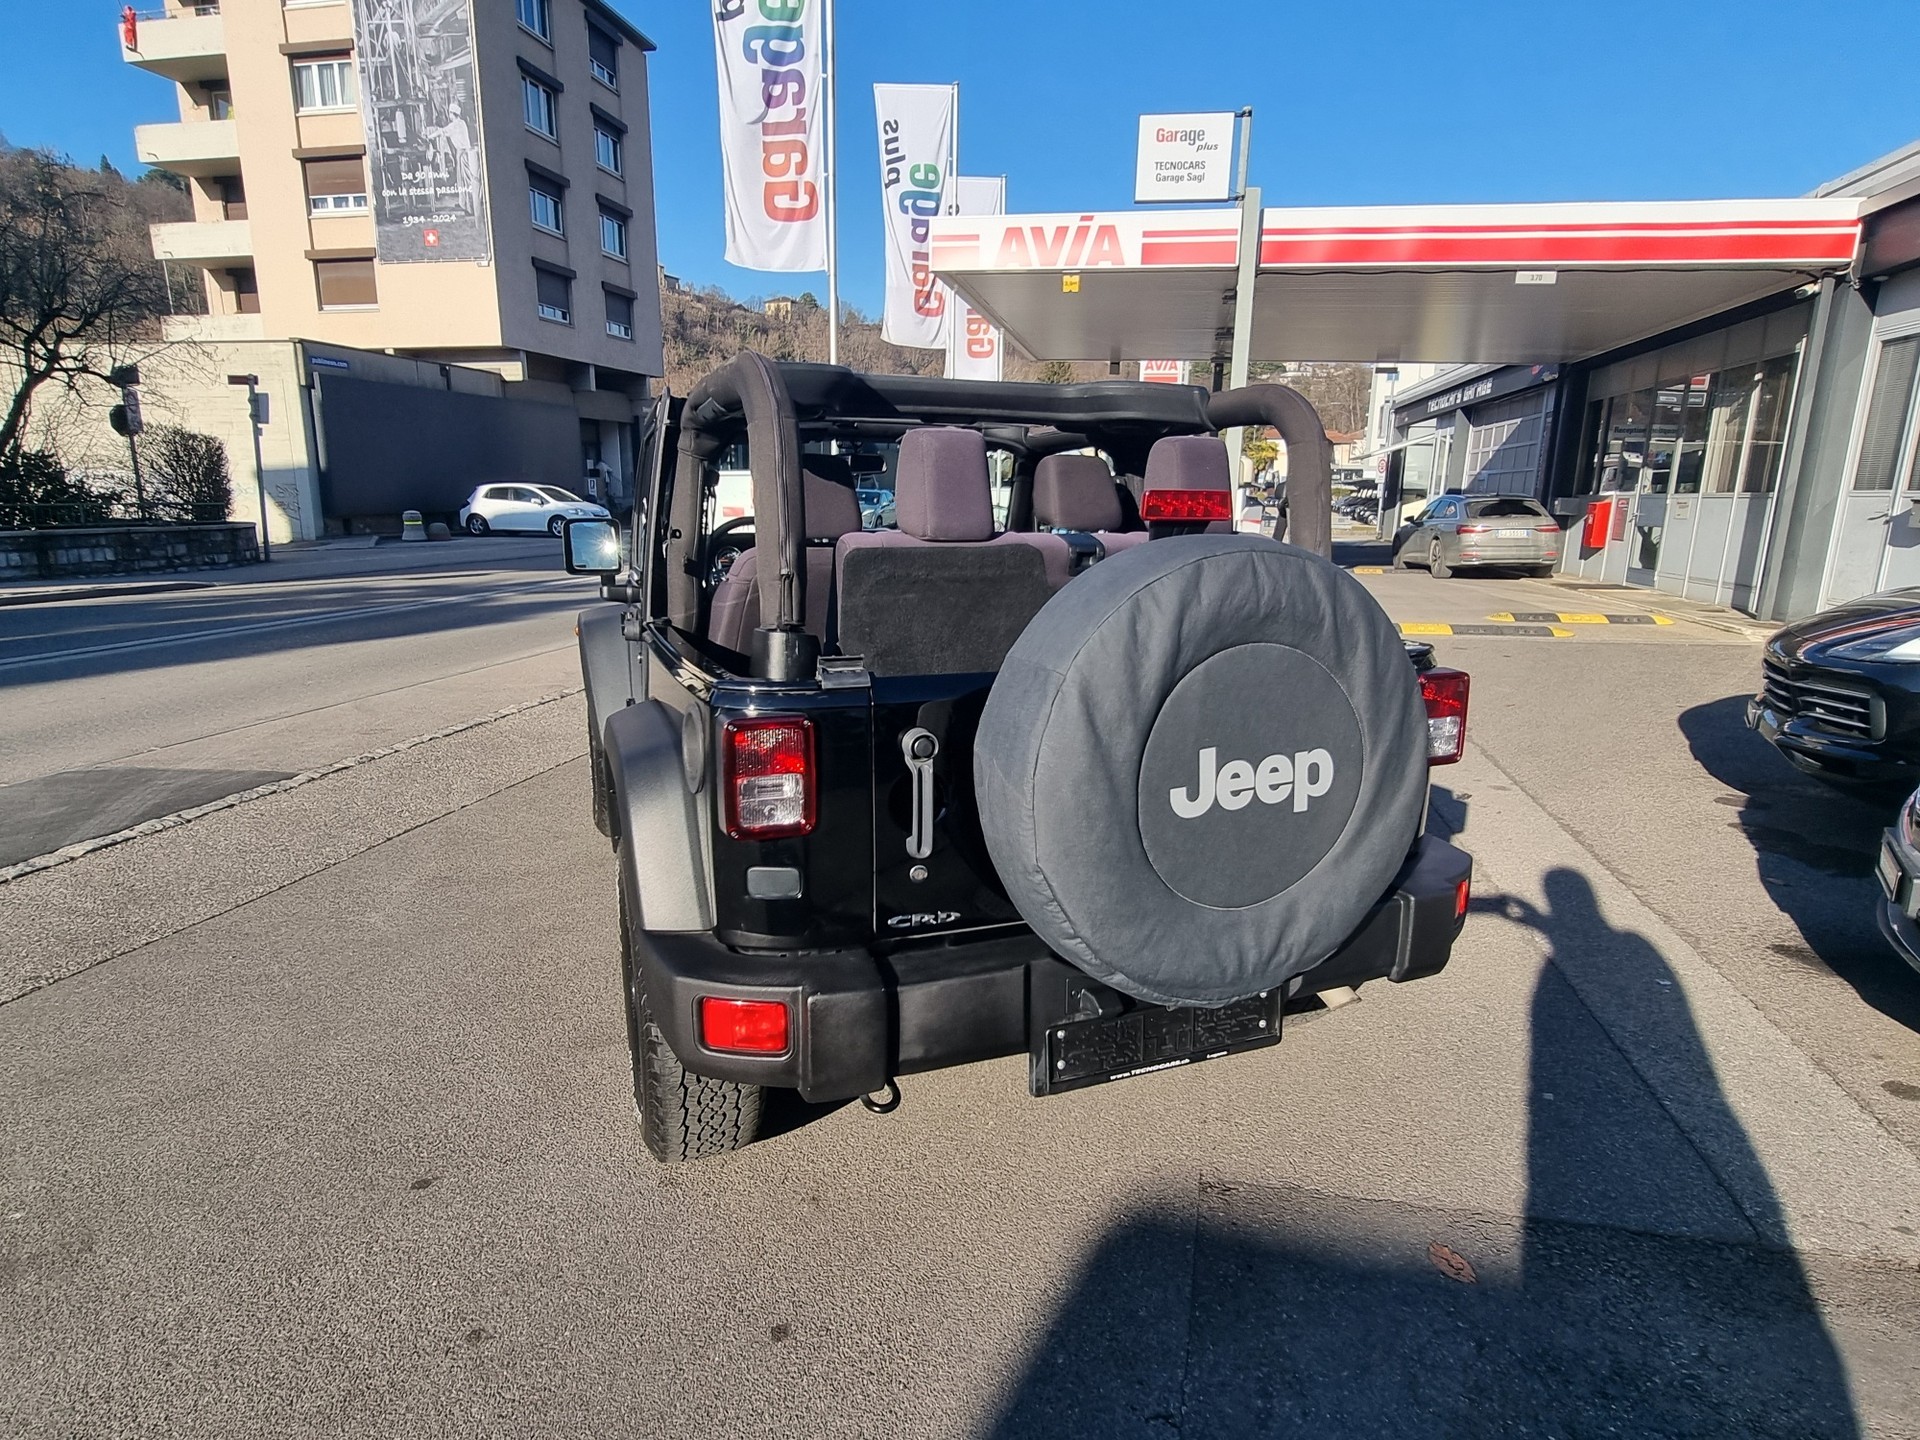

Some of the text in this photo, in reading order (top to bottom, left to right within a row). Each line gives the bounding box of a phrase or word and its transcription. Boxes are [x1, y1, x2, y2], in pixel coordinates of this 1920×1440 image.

[1155, 127, 1206, 146] Garage
[1195, 142, 1219, 153] plus
[1154, 160, 1206, 171] TECNOCARS
[401, 168, 450, 183] Da 90 anni
[1155, 172, 1206, 184] Garage Sagl
[382, 183, 473, 198] con la stessa passione
[402, 215, 424, 227] 1934
[432, 214, 457, 223] 2024
[1169, 747, 1334, 819] Jeep
[887, 910, 961, 928] CRD
